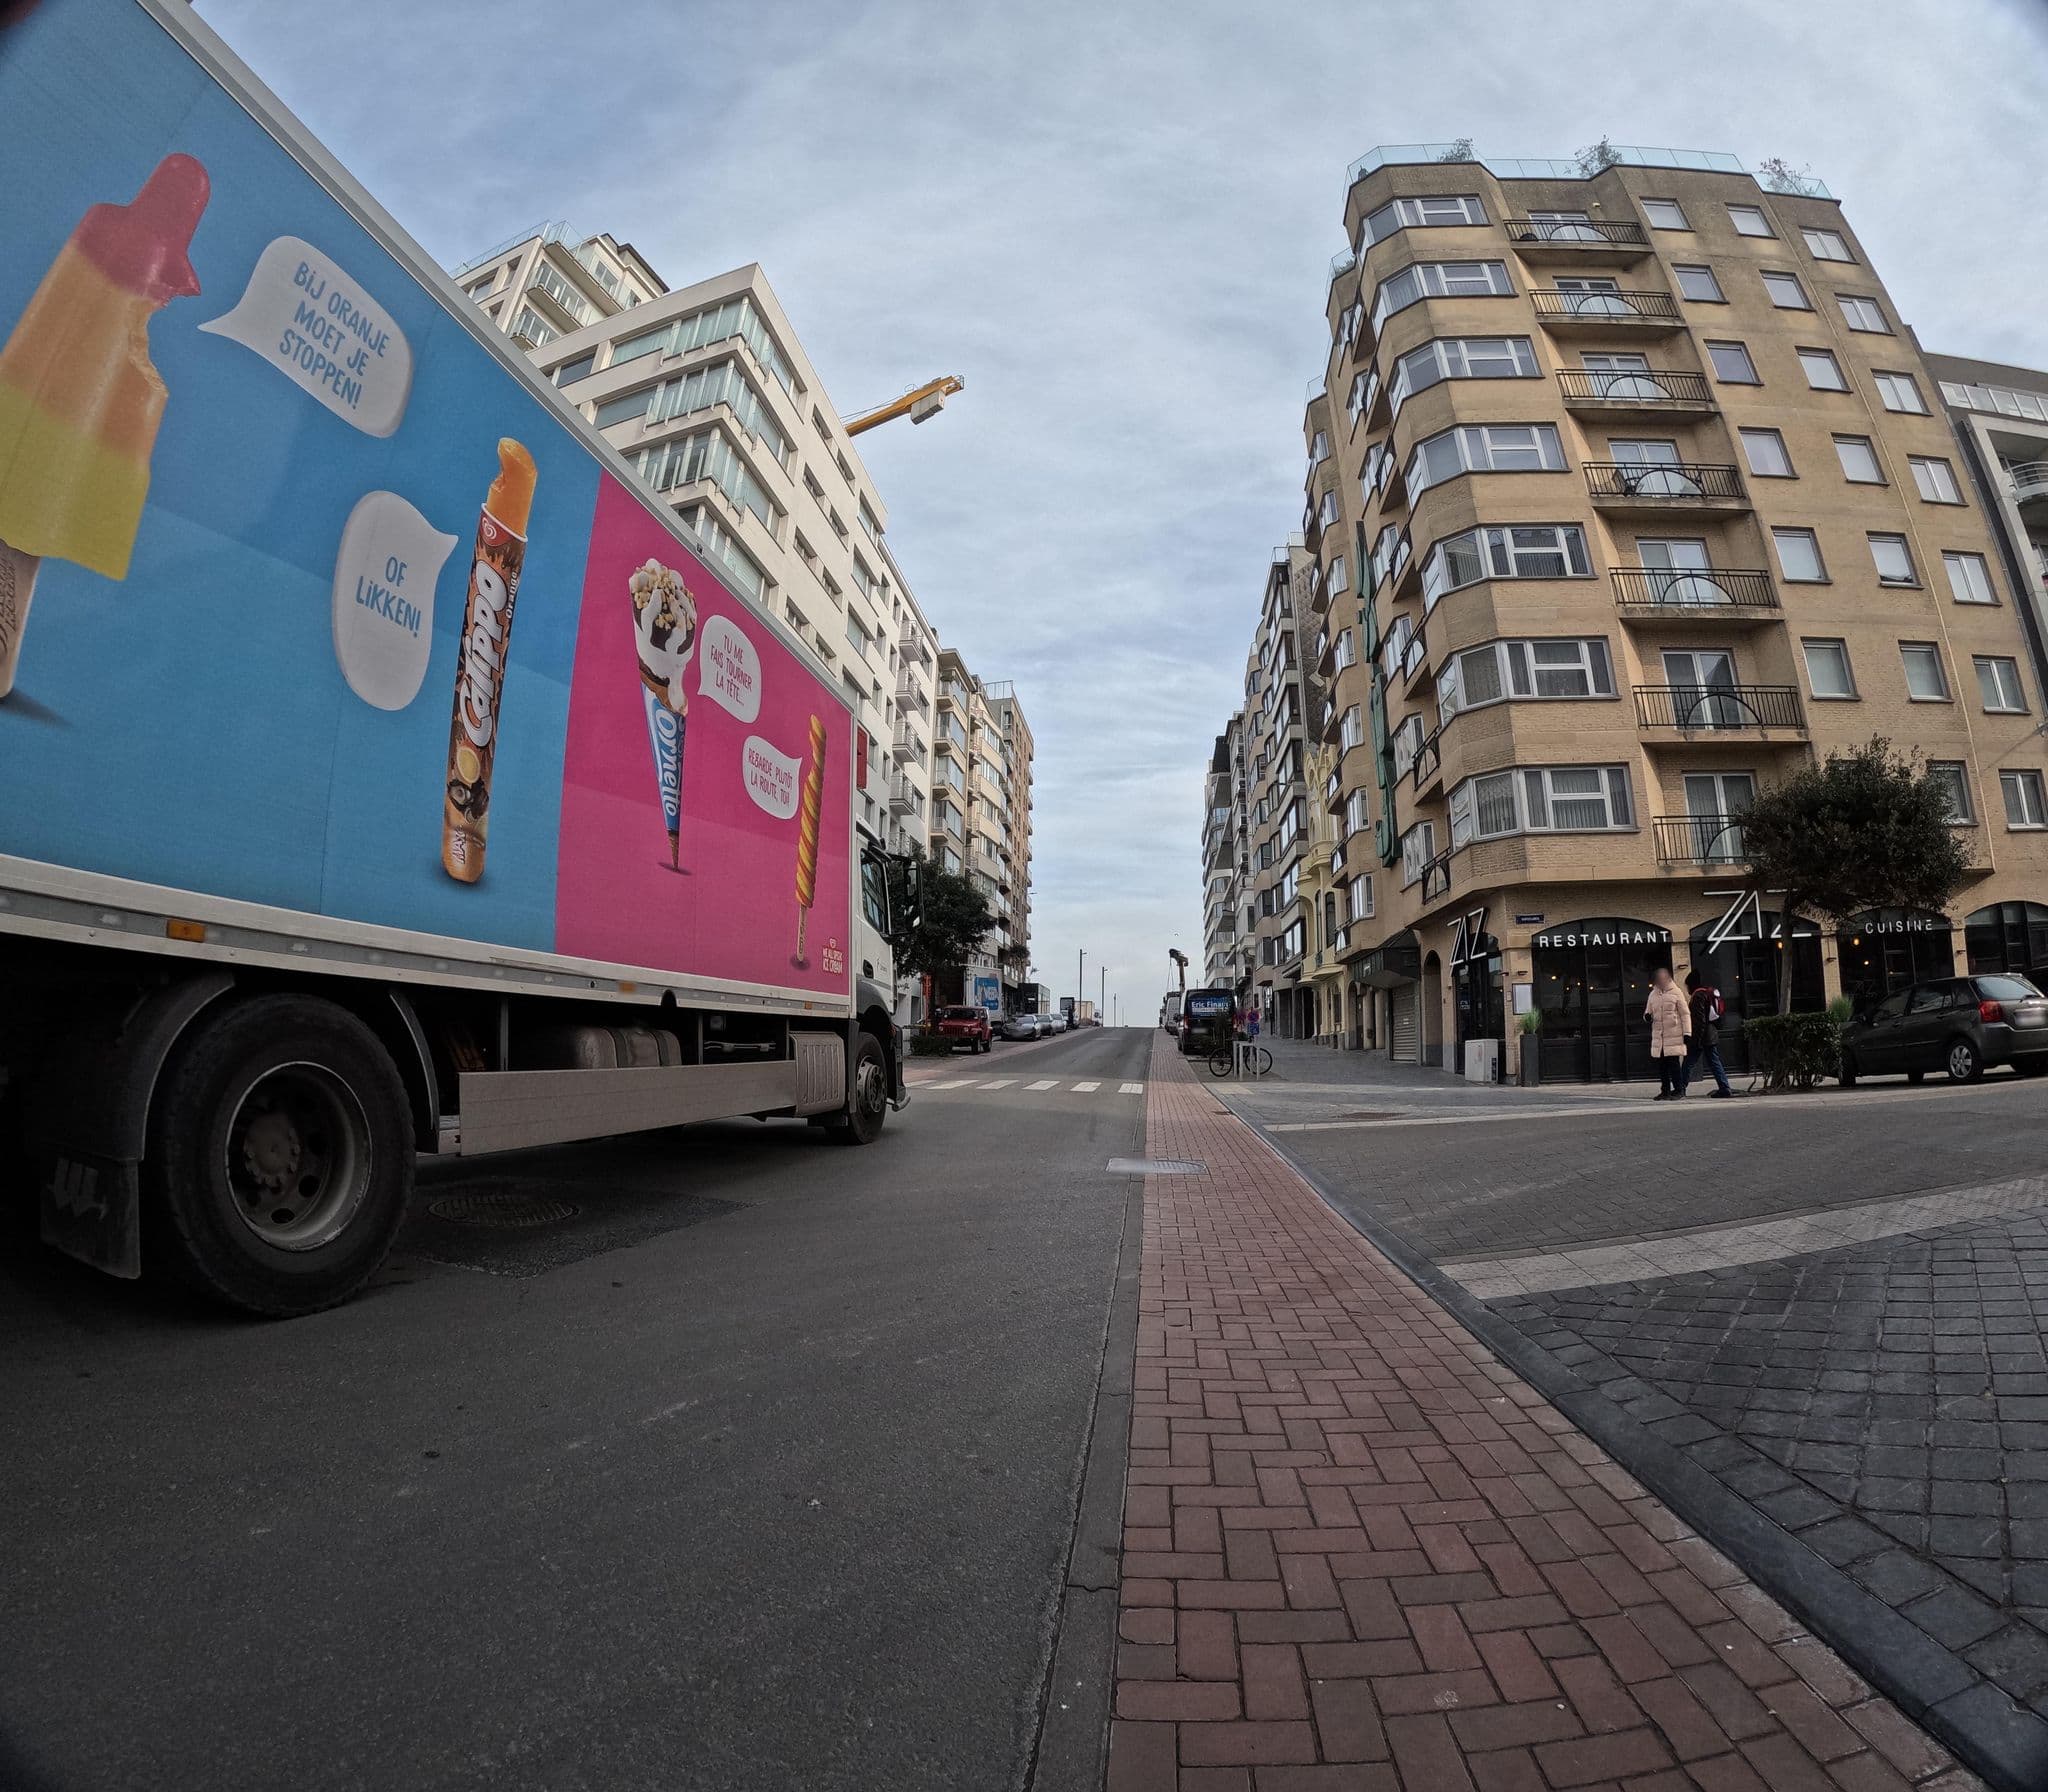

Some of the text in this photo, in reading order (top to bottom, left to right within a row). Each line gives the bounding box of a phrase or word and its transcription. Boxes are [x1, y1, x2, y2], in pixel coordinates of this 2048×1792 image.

[294, 301, 369, 377] MOET JE
[328, 292, 390, 358] ORANJE
[279, 329, 362, 410] STOPPEN!
[386, 556, 407, 587] OF
[505, 571, 518, 619] Orange
[459, 559, 508, 747] Calippo
[710, 645, 753, 693] FAIS TOURNER
[724, 635, 744, 665] TU ME
[715, 671, 724, 689] LA
[750, 770, 758, 787] LA
[1539, 930, 1669, 948] RESTAURANT
[1865, 919, 1933, 934] CUISINE
